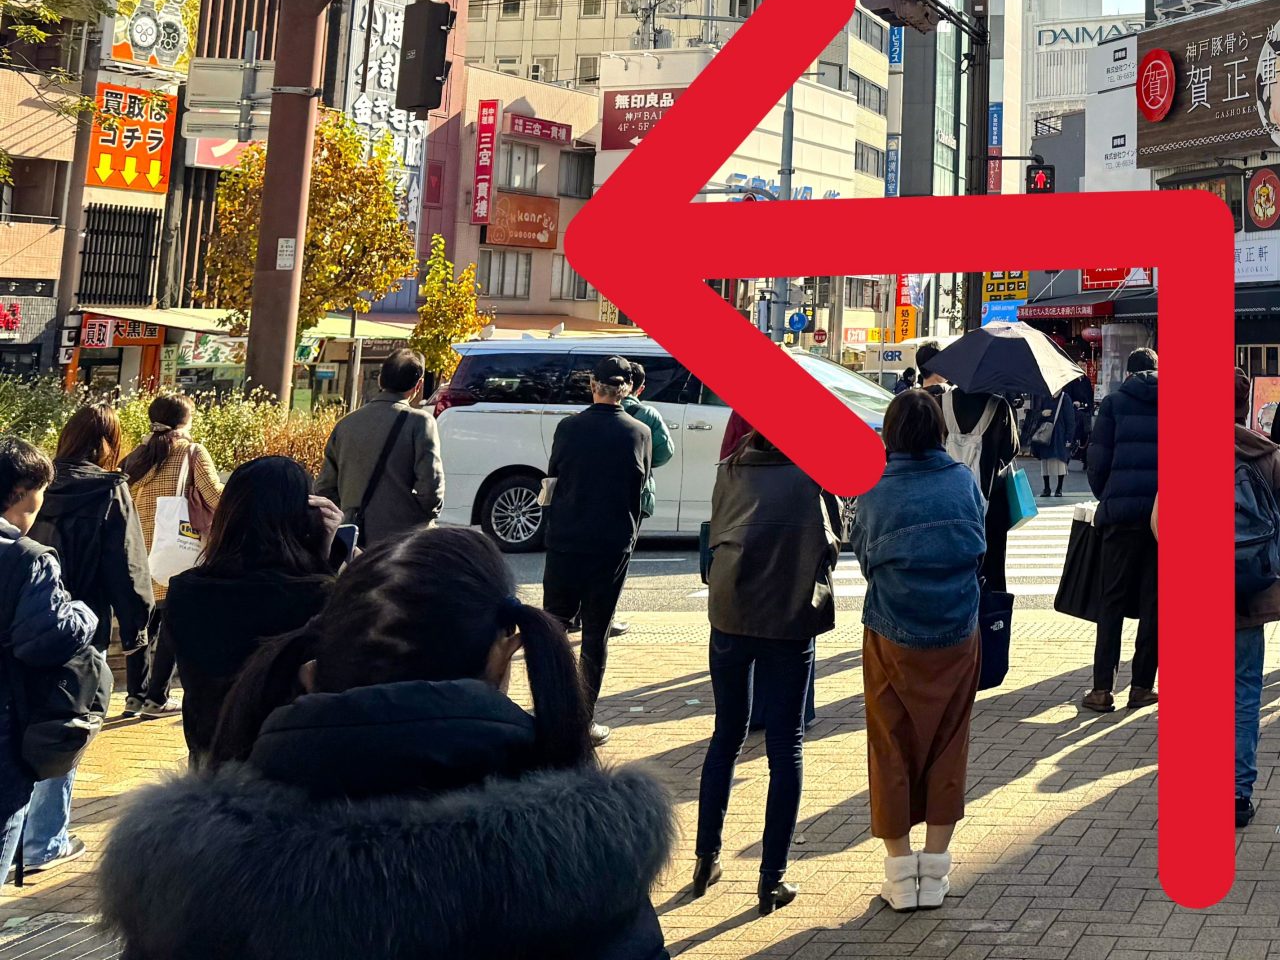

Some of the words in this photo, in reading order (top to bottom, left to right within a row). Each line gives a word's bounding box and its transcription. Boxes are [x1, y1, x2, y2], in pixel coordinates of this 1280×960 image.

[1143, 60, 1169, 103] 賀
[101, 89, 168, 122] 買取は
[614, 93, 675, 109] 無印良品
[99, 124, 165, 154] コチラ
[85, 323, 106, 346] 買取
[113, 320, 159, 339] 大黒屋
[901, 309, 909, 341] 処方せ
